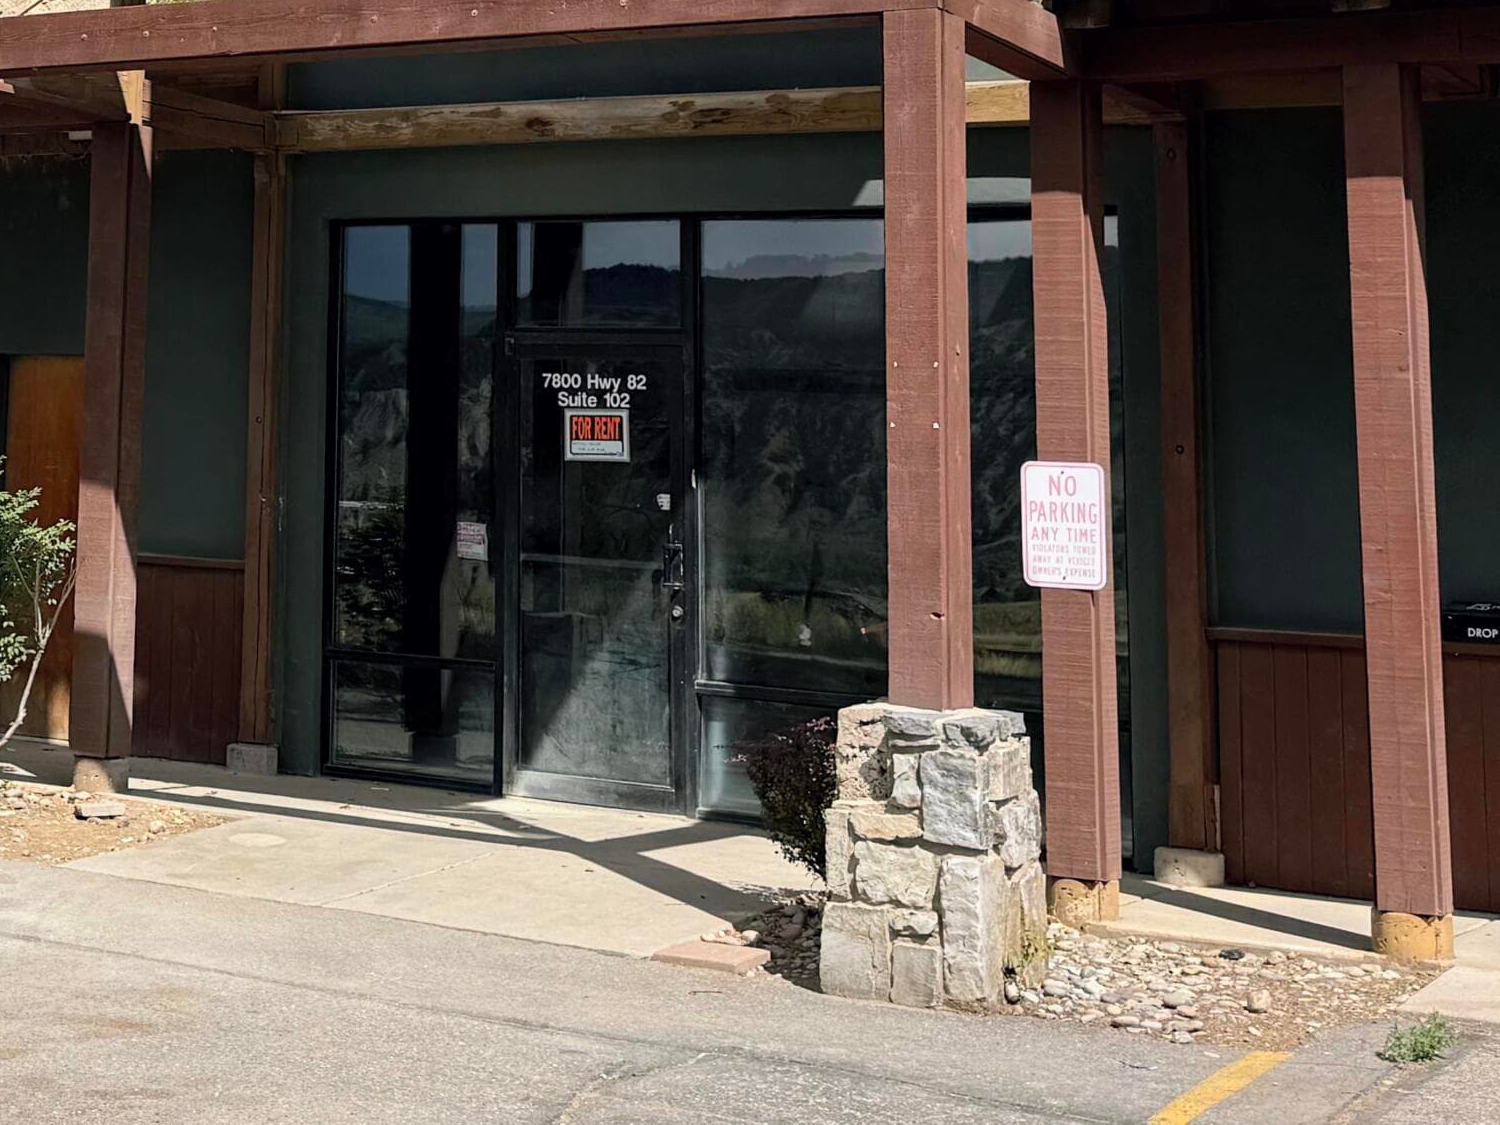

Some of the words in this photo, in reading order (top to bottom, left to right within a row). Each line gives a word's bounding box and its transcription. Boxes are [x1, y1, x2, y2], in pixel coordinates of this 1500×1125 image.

[542, 373, 581, 389] 7800
[587, 374, 621, 392] Hwy
[627, 375, 647, 390] 82
[558, 391, 597, 407] Suite
[604, 393, 630, 408] 102
[572, 416, 591, 440] FOR
[594, 416, 621, 440] RENT
[1048, 475, 1077, 496] NO
[1029, 500, 1097, 524] PARKING
[1031, 526, 1059, 542] ANY
[1067, 527, 1097, 544] TIME
[1032, 544, 1069, 554] VIOLATORS
[1073, 545, 1096, 555] TOWED
[1033, 555, 1051, 564] AWAY
[1467, 627, 1499, 638] DROP
